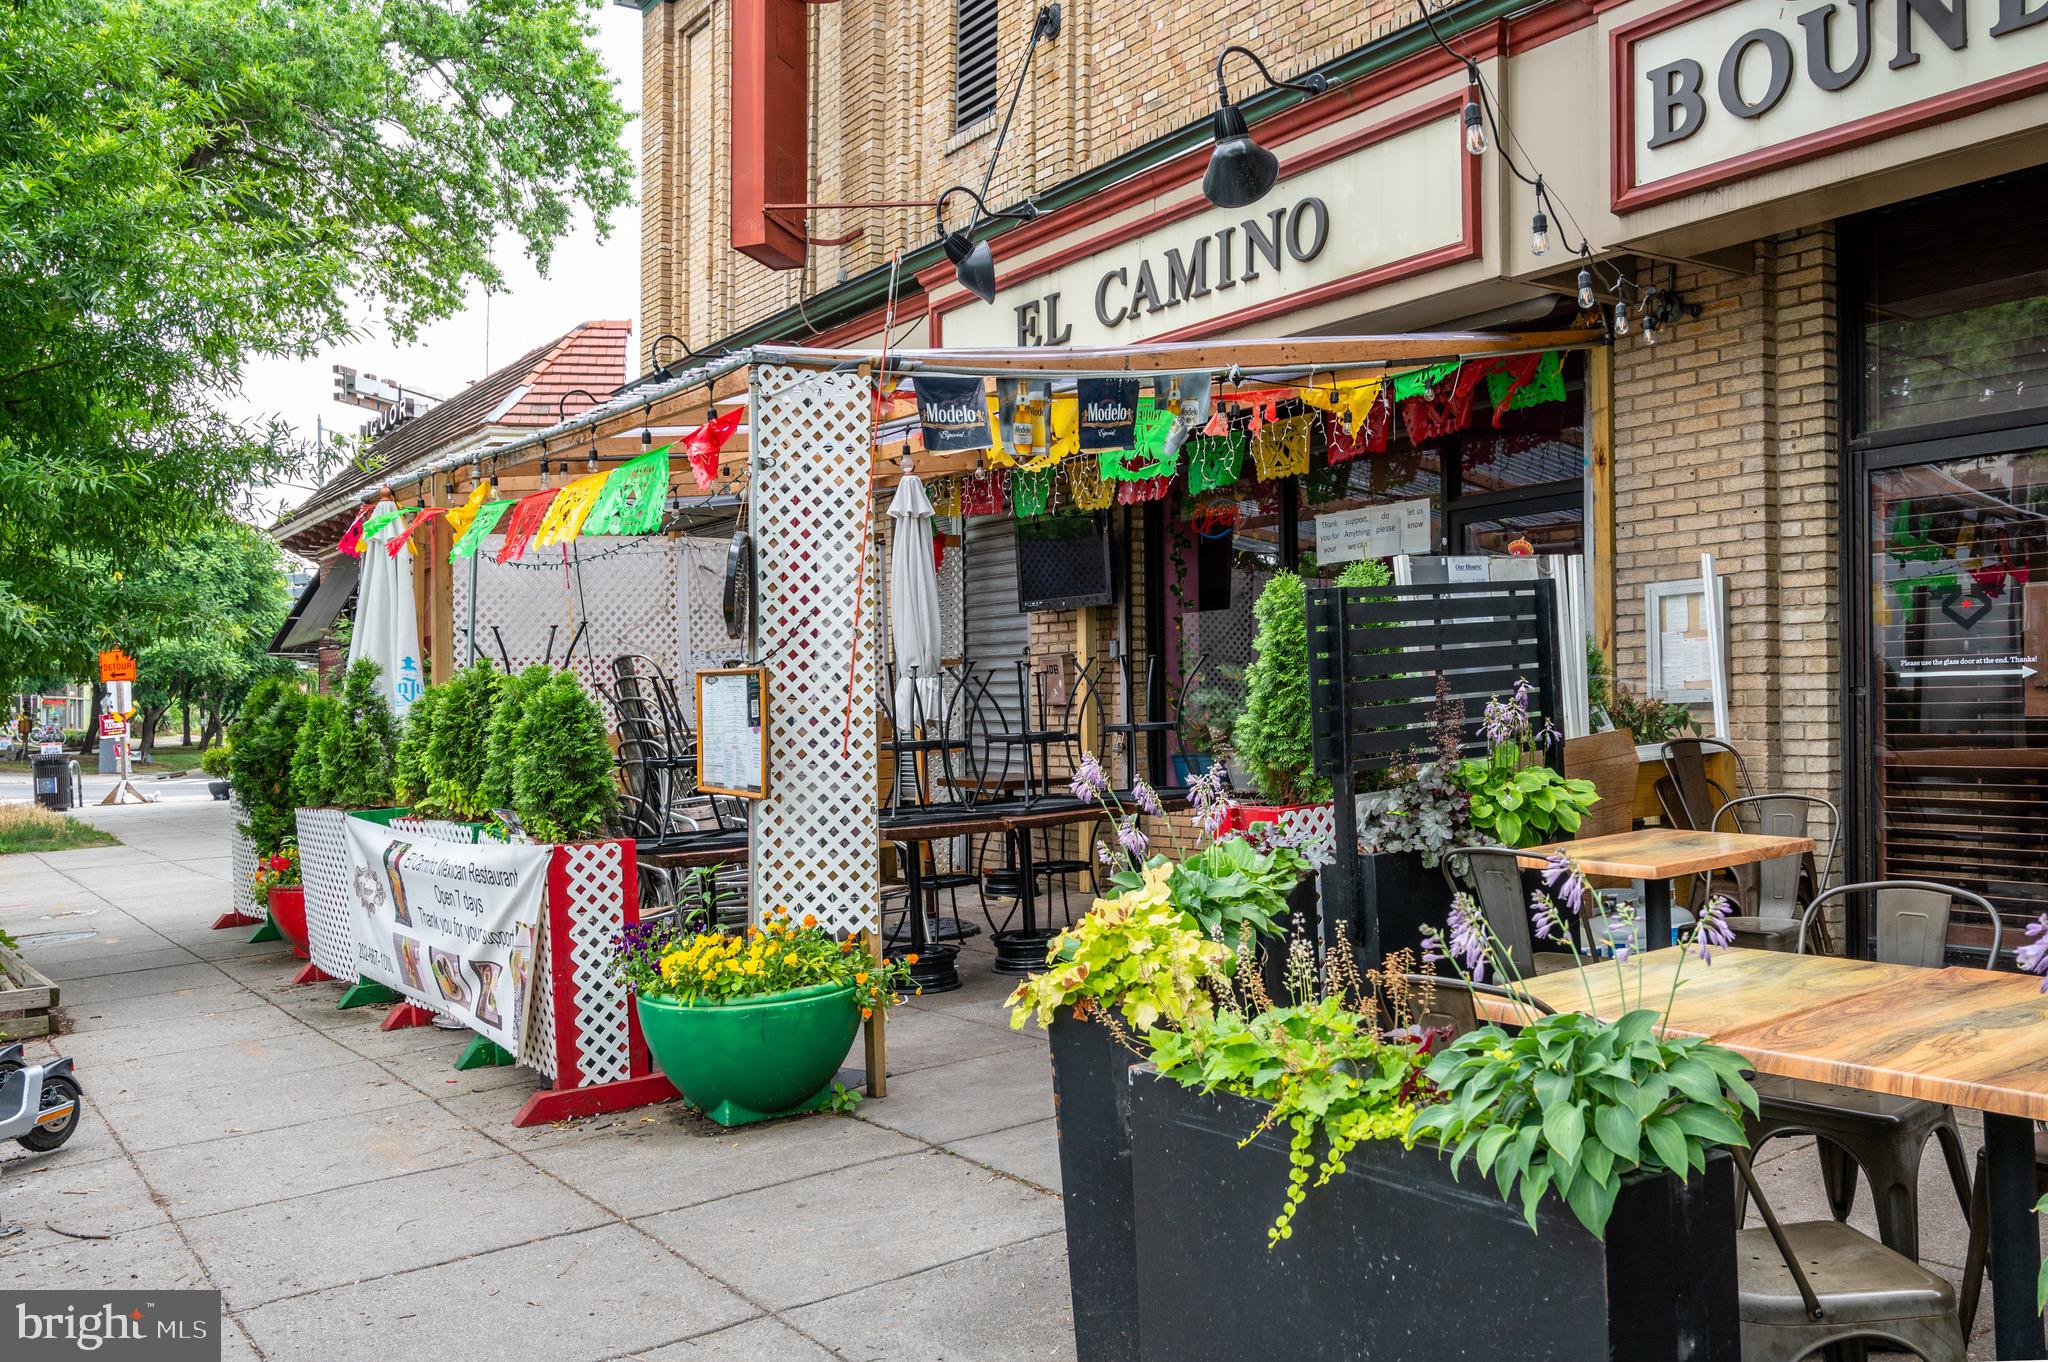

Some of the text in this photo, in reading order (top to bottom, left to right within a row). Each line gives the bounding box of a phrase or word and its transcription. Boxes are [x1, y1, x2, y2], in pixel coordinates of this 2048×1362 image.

[1013, 196, 1329, 347] EL CAMINO
[926, 403, 976, 422] Modelo
[1087, 402, 1127, 422] Modelo
[1381, 512, 1390, 520] do
[1407, 508, 1415, 516] let
[1321, 520, 1338, 529] Thank
[1376, 525, 1396, 534] please
[1343, 529, 1370, 539] Anything
[1323, 546, 1337, 555] your
[1943, 658, 1959, 667] glass
[1995, 656, 2009, 664] end.
[2010, 655, 2037, 663] Thanks!
[103, 662, 132, 672] DETOUR
[437, 858, 467, 881] Mexican
[469, 862, 518, 888] Restaurant
[434, 884, 483, 917] Open 7 days
[417, 906, 515, 950] Thank you for your support
